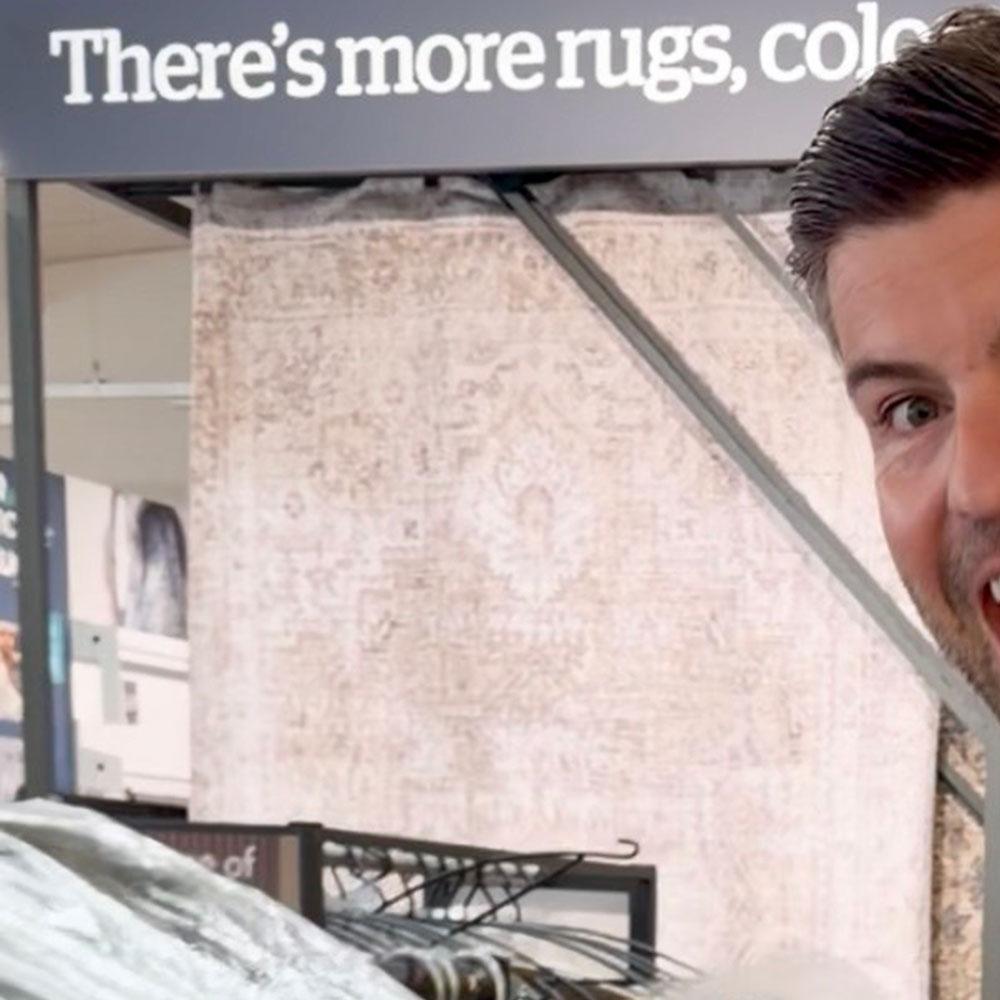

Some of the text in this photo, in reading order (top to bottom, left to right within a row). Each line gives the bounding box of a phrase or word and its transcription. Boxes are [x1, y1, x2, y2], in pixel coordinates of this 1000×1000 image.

[49, 21, 326, 104] There's
[335, 35, 546, 96] more
[555, 24, 747, 103] rugs,
[223, 845, 257, 878] of
